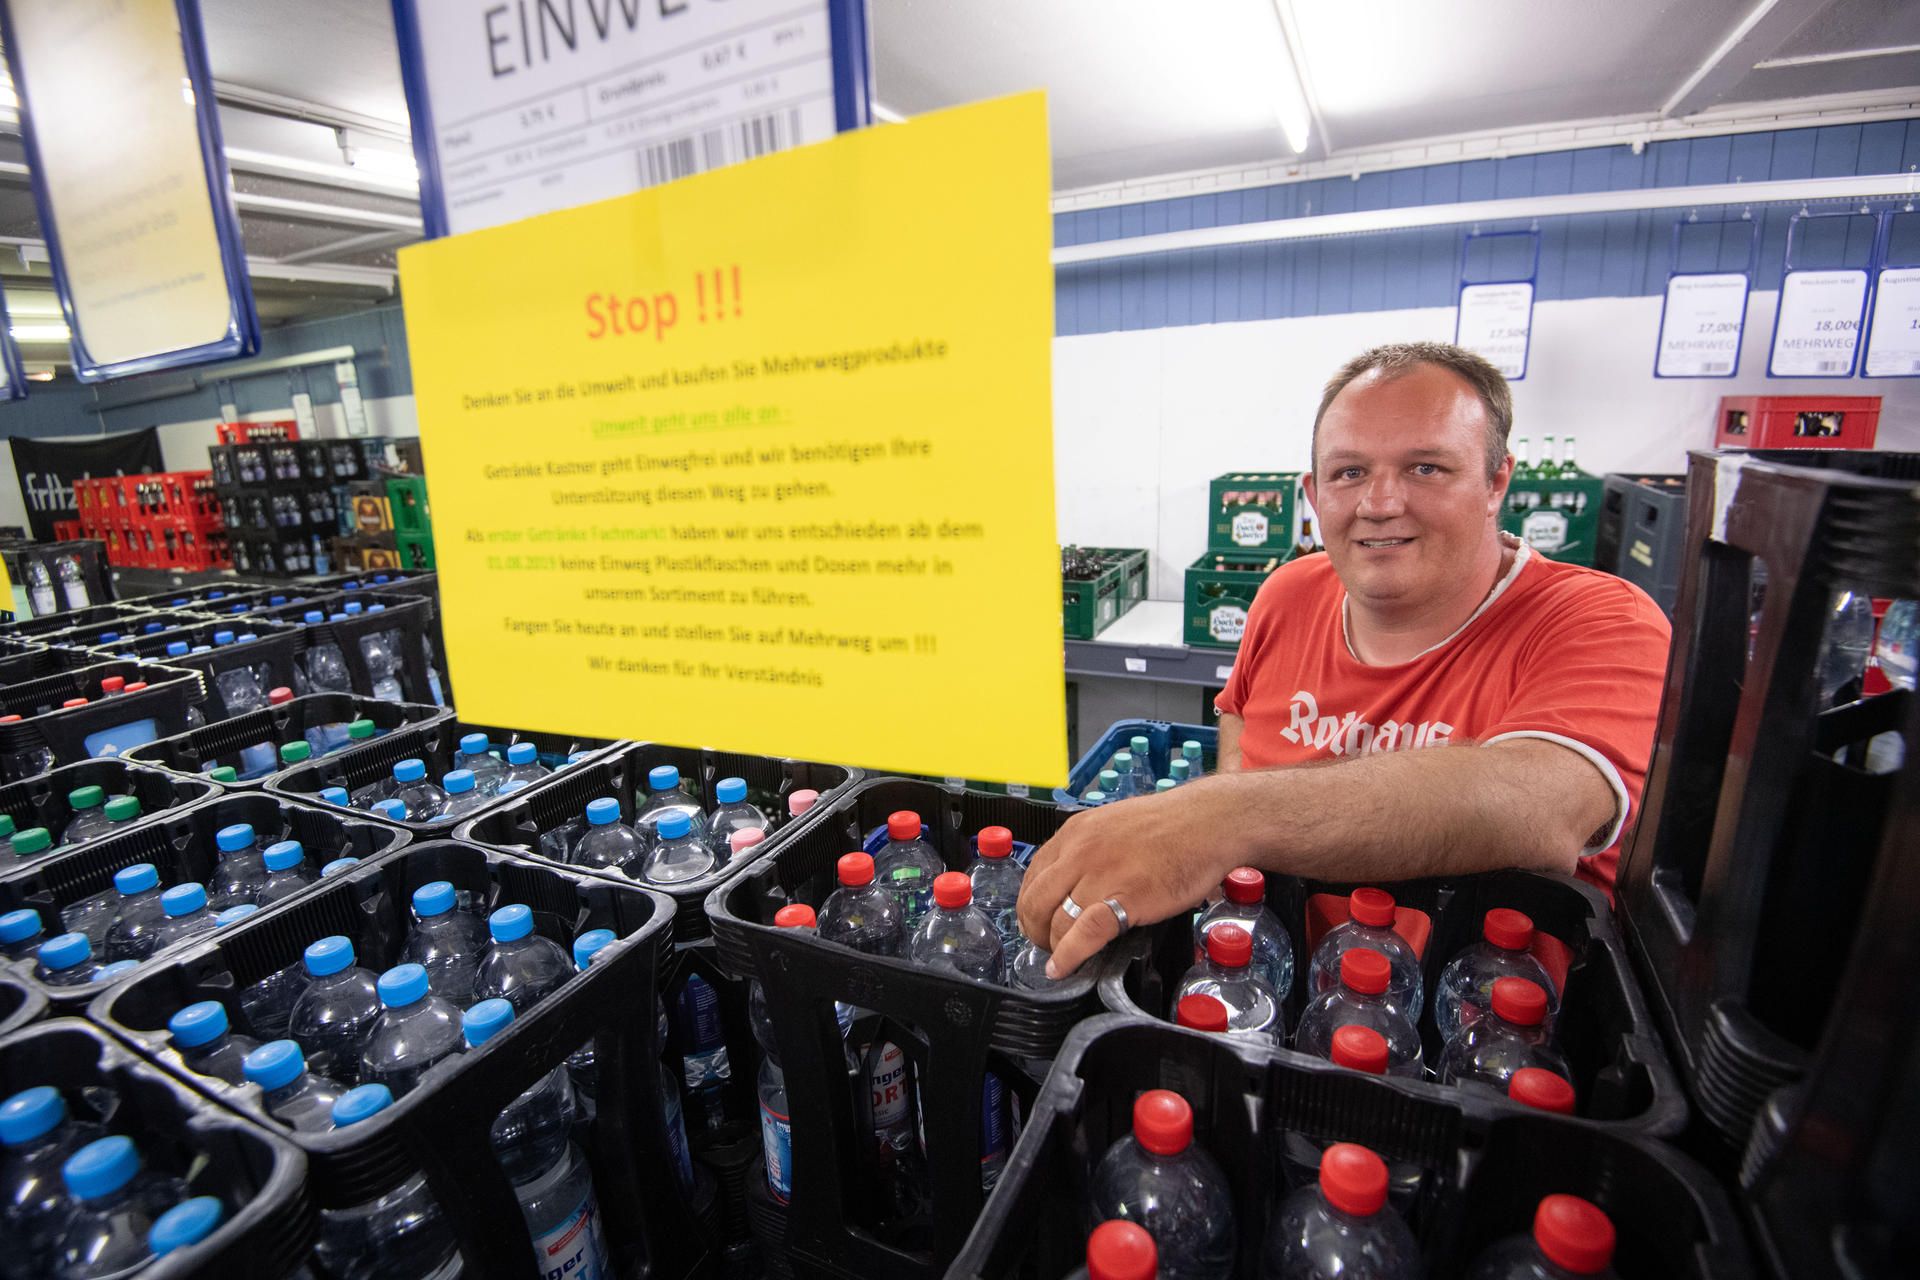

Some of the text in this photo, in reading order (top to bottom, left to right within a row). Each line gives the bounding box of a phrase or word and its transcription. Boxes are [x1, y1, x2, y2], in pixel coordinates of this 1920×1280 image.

[586, 263, 744, 342] Stop !!!
[1815, 319, 1861, 332] 18,00€
[1782, 338, 1854, 350] MEHRWEG
[463, 338, 947, 411] Denken Sie an die Umwelt und kaufen Sie Mehrwegprodukte
[654, 411, 685, 433] geht
[693, 411, 718, 427] uns
[484, 462, 542, 479] Getränke
[601, 458, 631, 475] geht
[637, 449, 715, 472] Einwegfrei
[722, 448, 752, 466] und
[759, 448, 784, 464] wir
[791, 440, 885, 465] benötigen
[891, 438, 931, 456] Ihre
[552, 488, 650, 506] Unterstützung
[656, 485, 703, 502] diesen
[711, 484, 745, 503] Weg
[751, 485, 769, 498] zu
[527, 528, 587, 542] Getränke
[591, 526, 667, 541] Fachmarkt
[671, 525, 719, 541] haben
[724, 524, 748, 540] wir
[754, 526, 784, 540] uns
[789, 521, 898, 540] entschieden
[907, 522, 931, 539] ab
[938, 518, 984, 538] dem
[560, 555, 595, 571] keine
[601, 555, 650, 575] Einweg
[655, 554, 772, 575] Plastikflaschen
[776, 556, 809, 574] und
[814, 555, 871, 575] Dosen
[876, 557, 926, 575] mehr
[932, 556, 953, 575] in
[583, 586, 647, 601] unserem
[650, 586, 724, 603] Sortiment
[729, 589, 747, 605] zu
[504, 617, 549, 635] Fangen
[553, 618, 571, 633] Sie
[576, 619, 615, 636] heute
[621, 624, 637, 638] an
[643, 624, 669, 640] und
[674, 625, 724, 642] stellen
[728, 626, 751, 643] Sie
[758, 626, 785, 645] auf
[789, 627, 873, 653] Mehrweg
[877, 637, 909, 653] um
[586, 656, 823, 688] Wir danken für Ihr Verständnis
